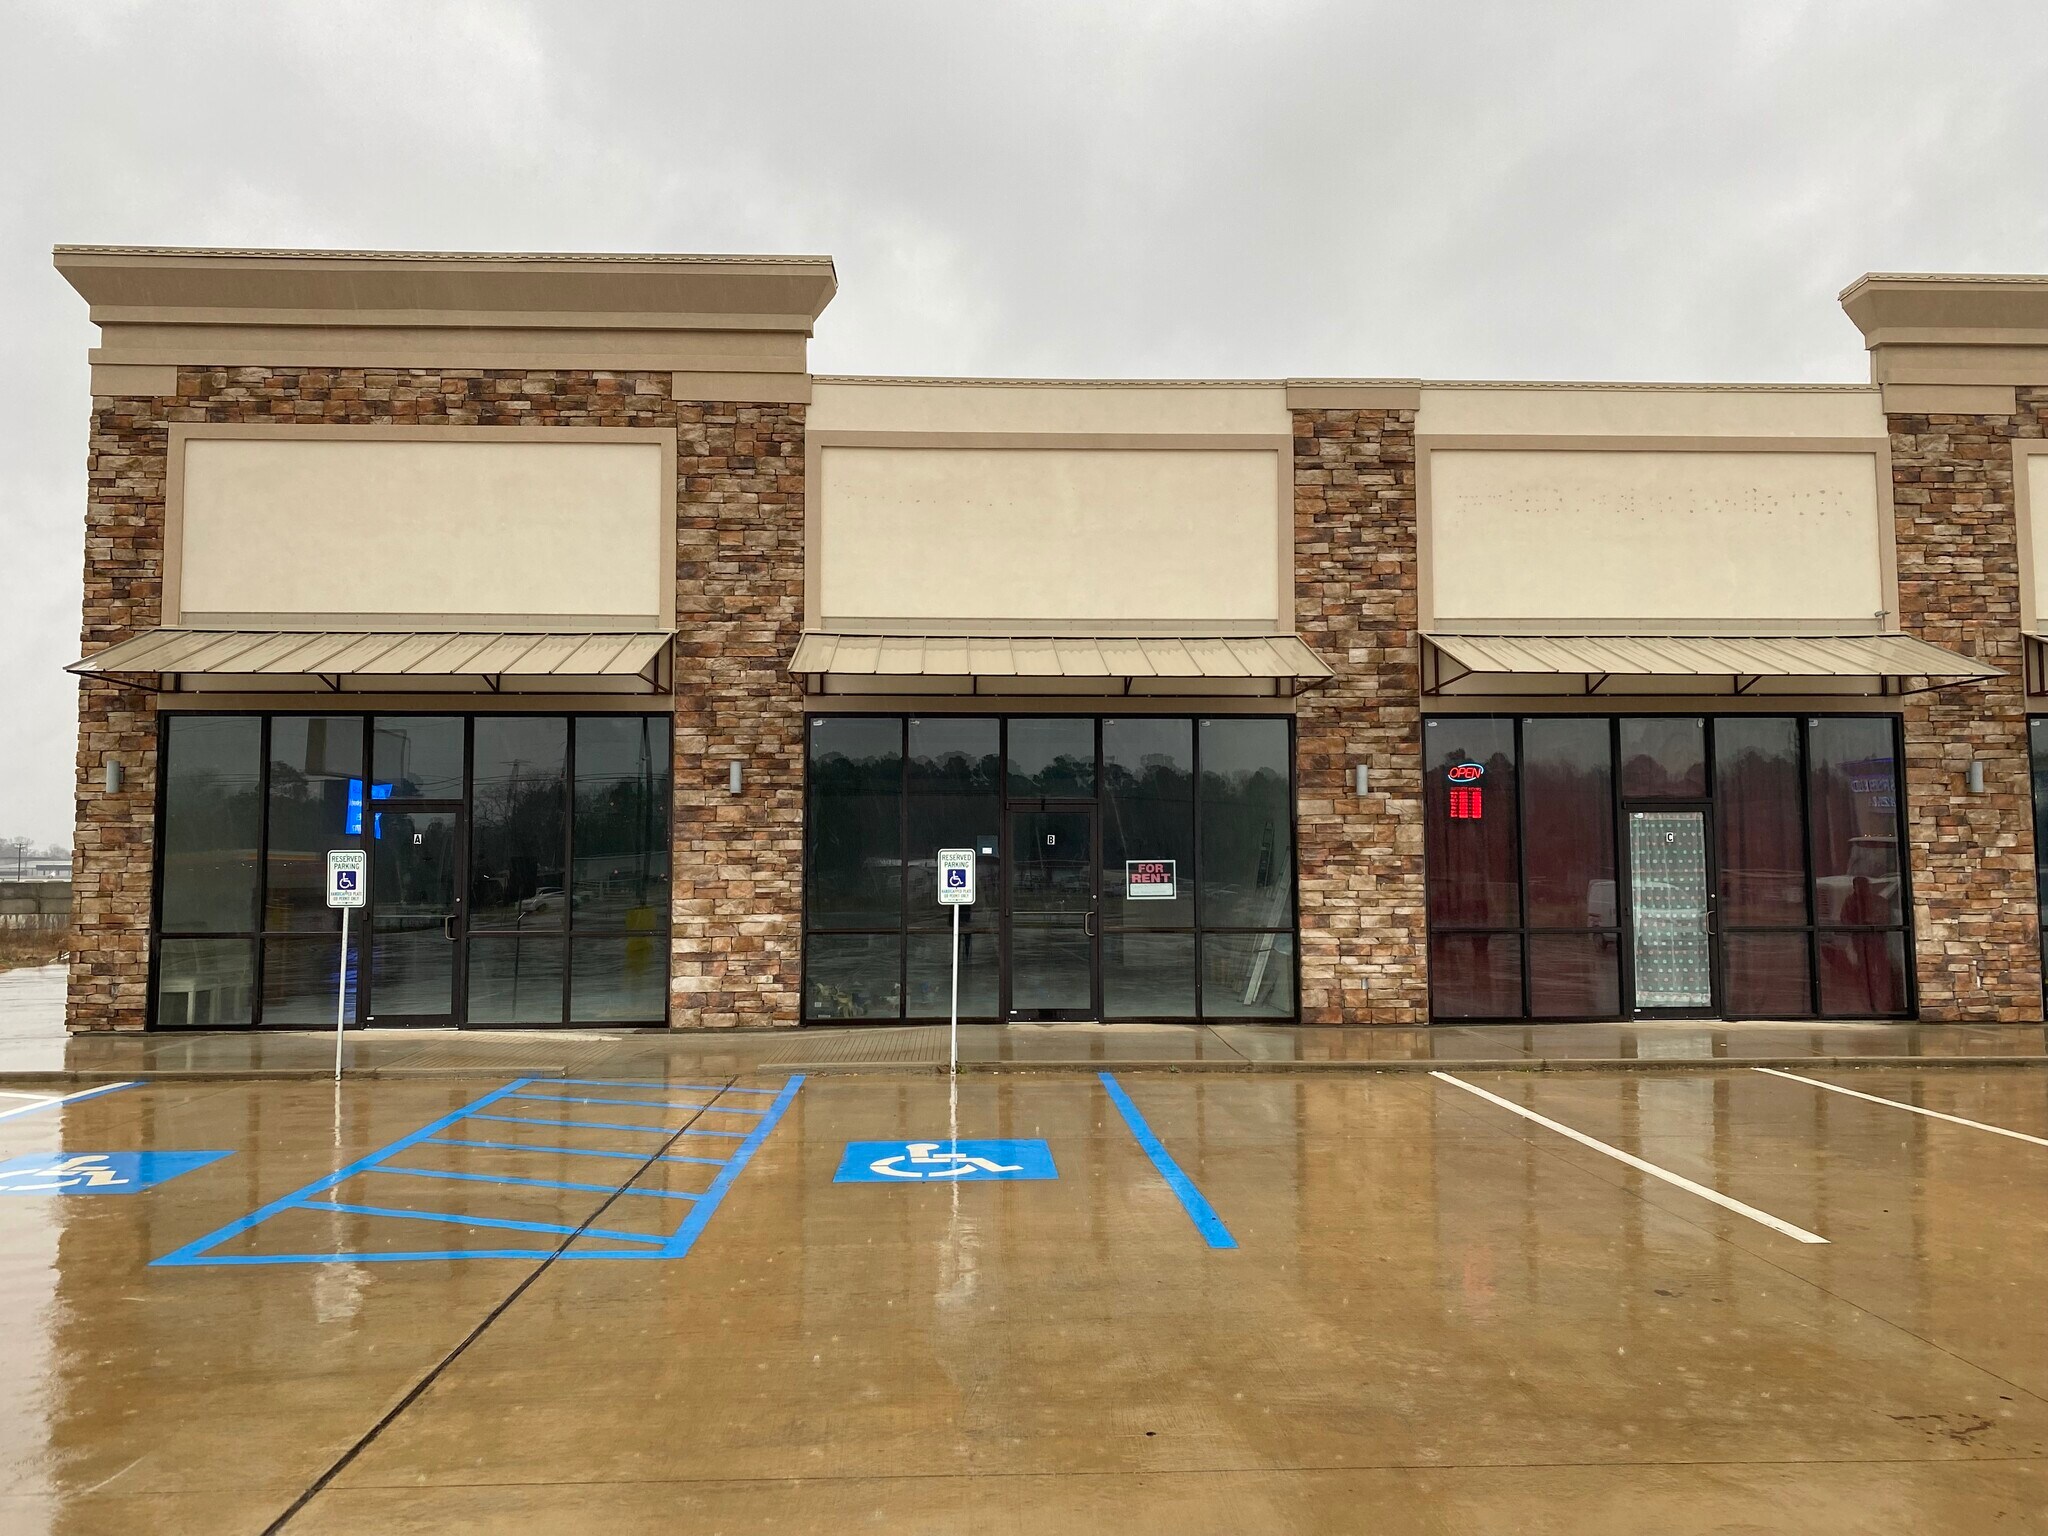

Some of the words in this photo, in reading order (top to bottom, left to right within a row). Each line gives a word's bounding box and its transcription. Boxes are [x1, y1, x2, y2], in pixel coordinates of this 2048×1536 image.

[1449, 767, 1481, 779] OPEN
[414, 834, 421, 844] A
[1138, 863, 1164, 873] FOR
[1131, 873, 1171, 883] RENT
